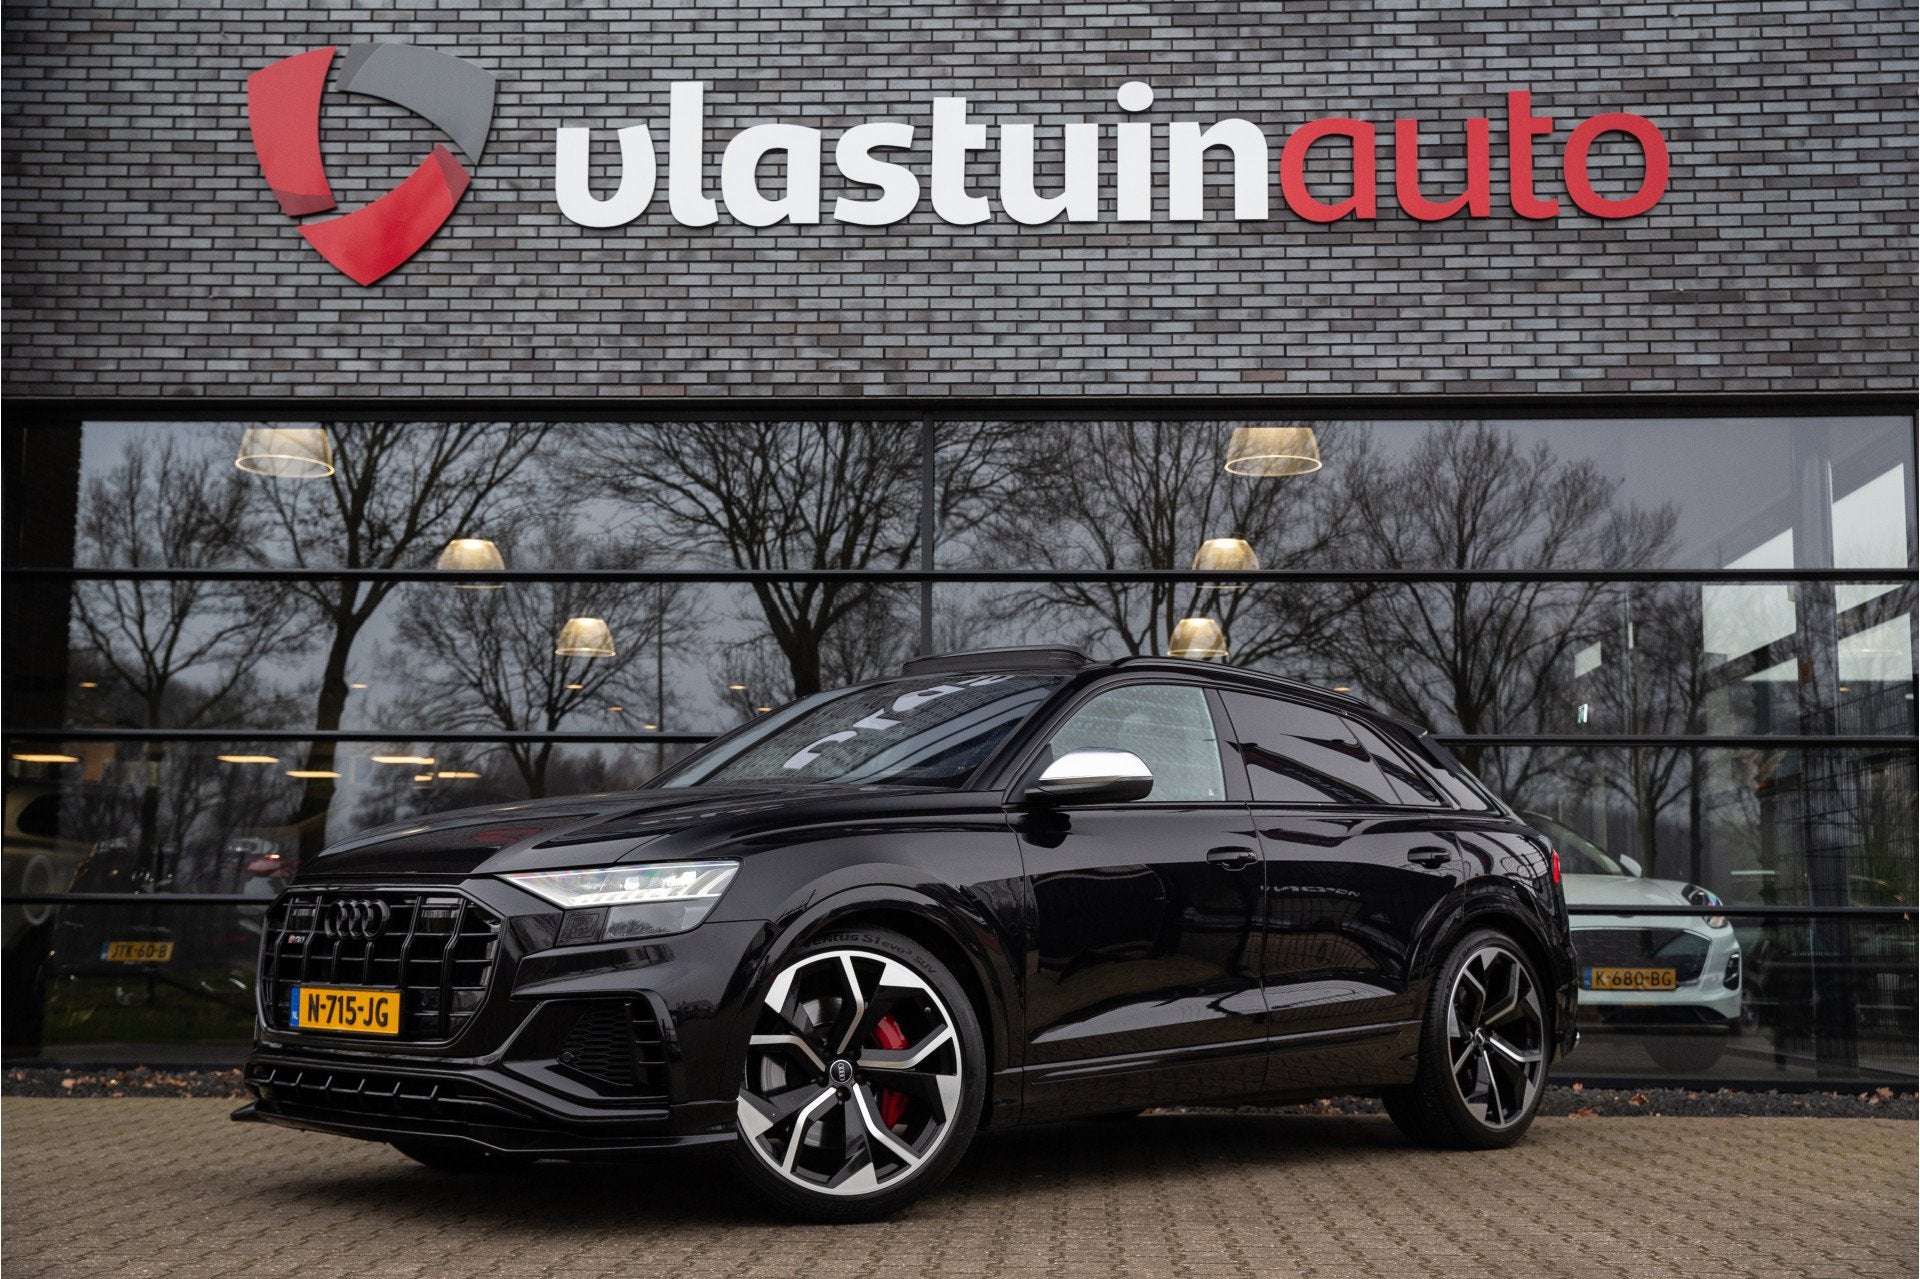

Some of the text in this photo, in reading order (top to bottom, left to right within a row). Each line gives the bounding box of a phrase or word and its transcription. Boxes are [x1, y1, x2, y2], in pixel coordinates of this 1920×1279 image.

[913, 955, 936, 974] SUV
[1596, 970, 1672, 987] K-680-BG
[307, 993, 389, 1027] N-715-JG
